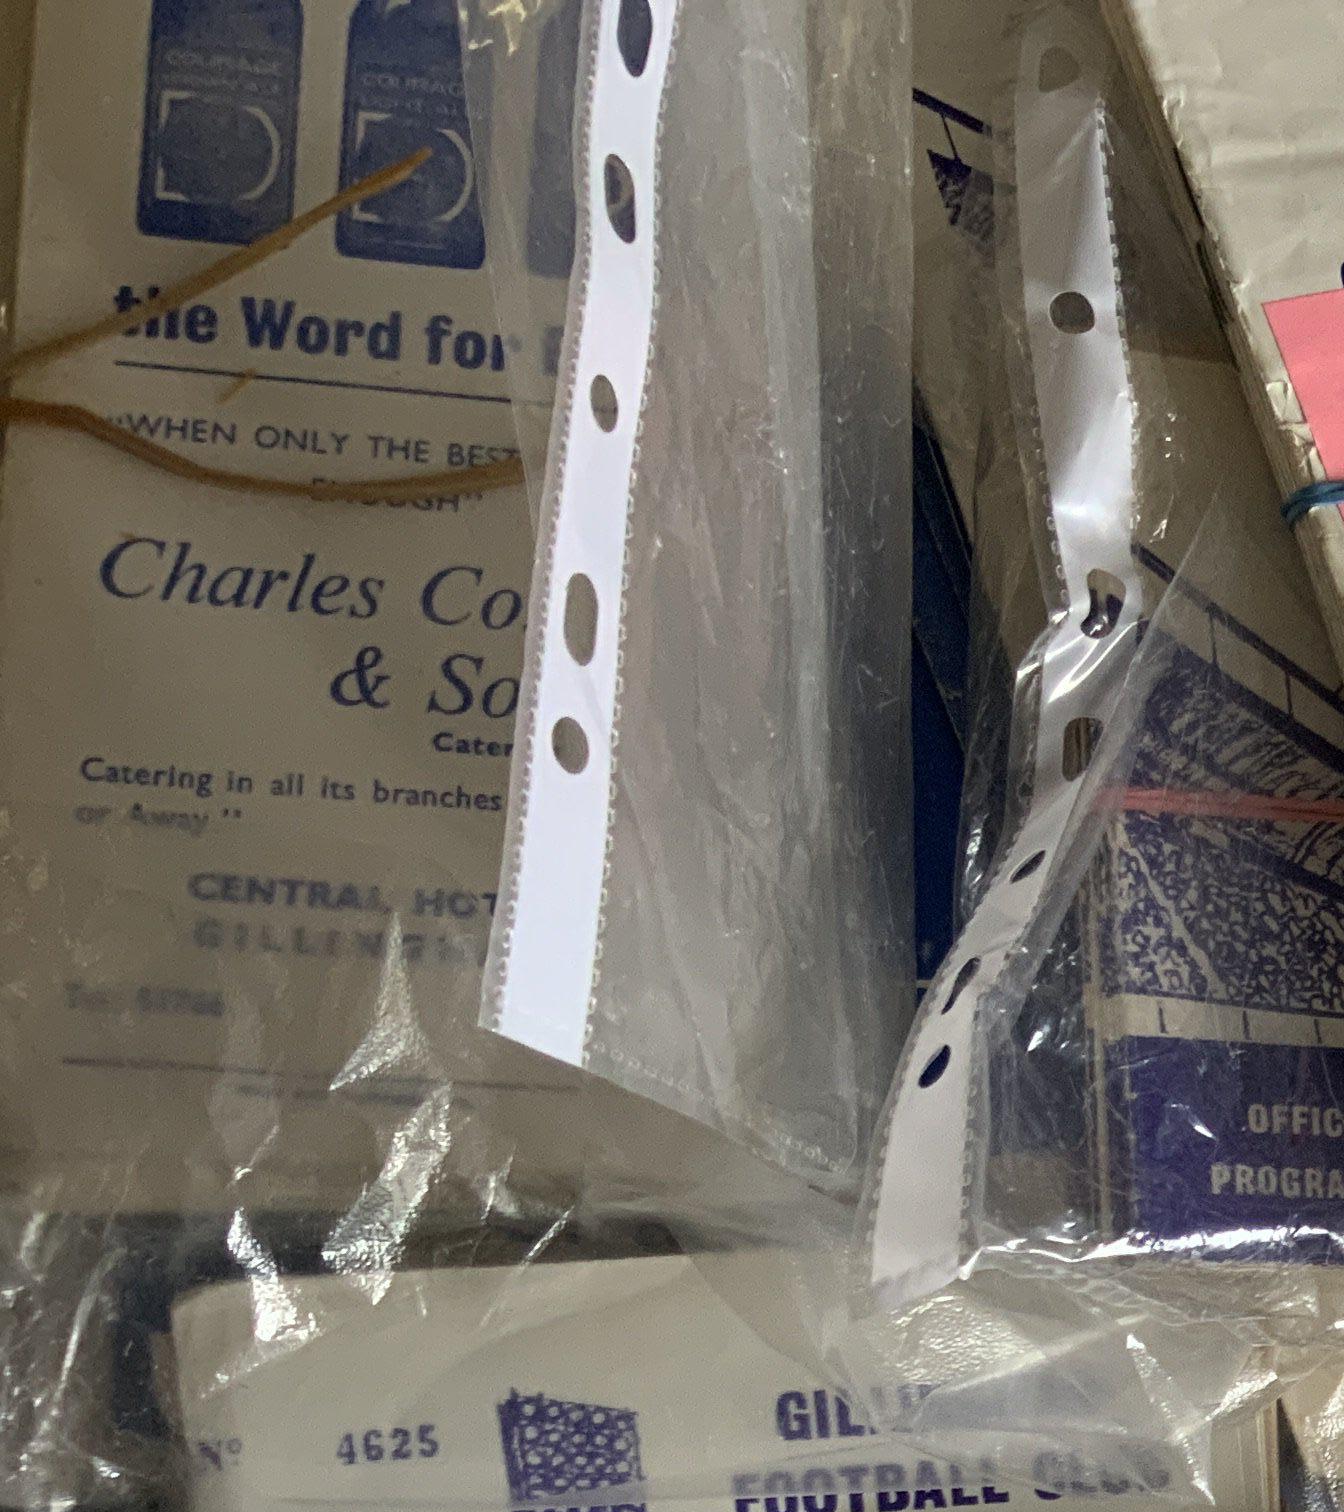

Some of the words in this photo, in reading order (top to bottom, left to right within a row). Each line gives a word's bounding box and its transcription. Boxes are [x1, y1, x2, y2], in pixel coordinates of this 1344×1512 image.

[240, 296, 402, 361] Word
[255, 425, 349, 456] ONLY
[368, 435, 430, 464] THE
[101, 537, 385, 619] Charles
[330, 645, 391, 709] &
[80, 756, 212, 799] Catering
[228, 769, 253, 795] in
[270, 773, 303, 796] all
[320, 778, 355, 801] its
[336, 1424, 440, 1465] 4625
